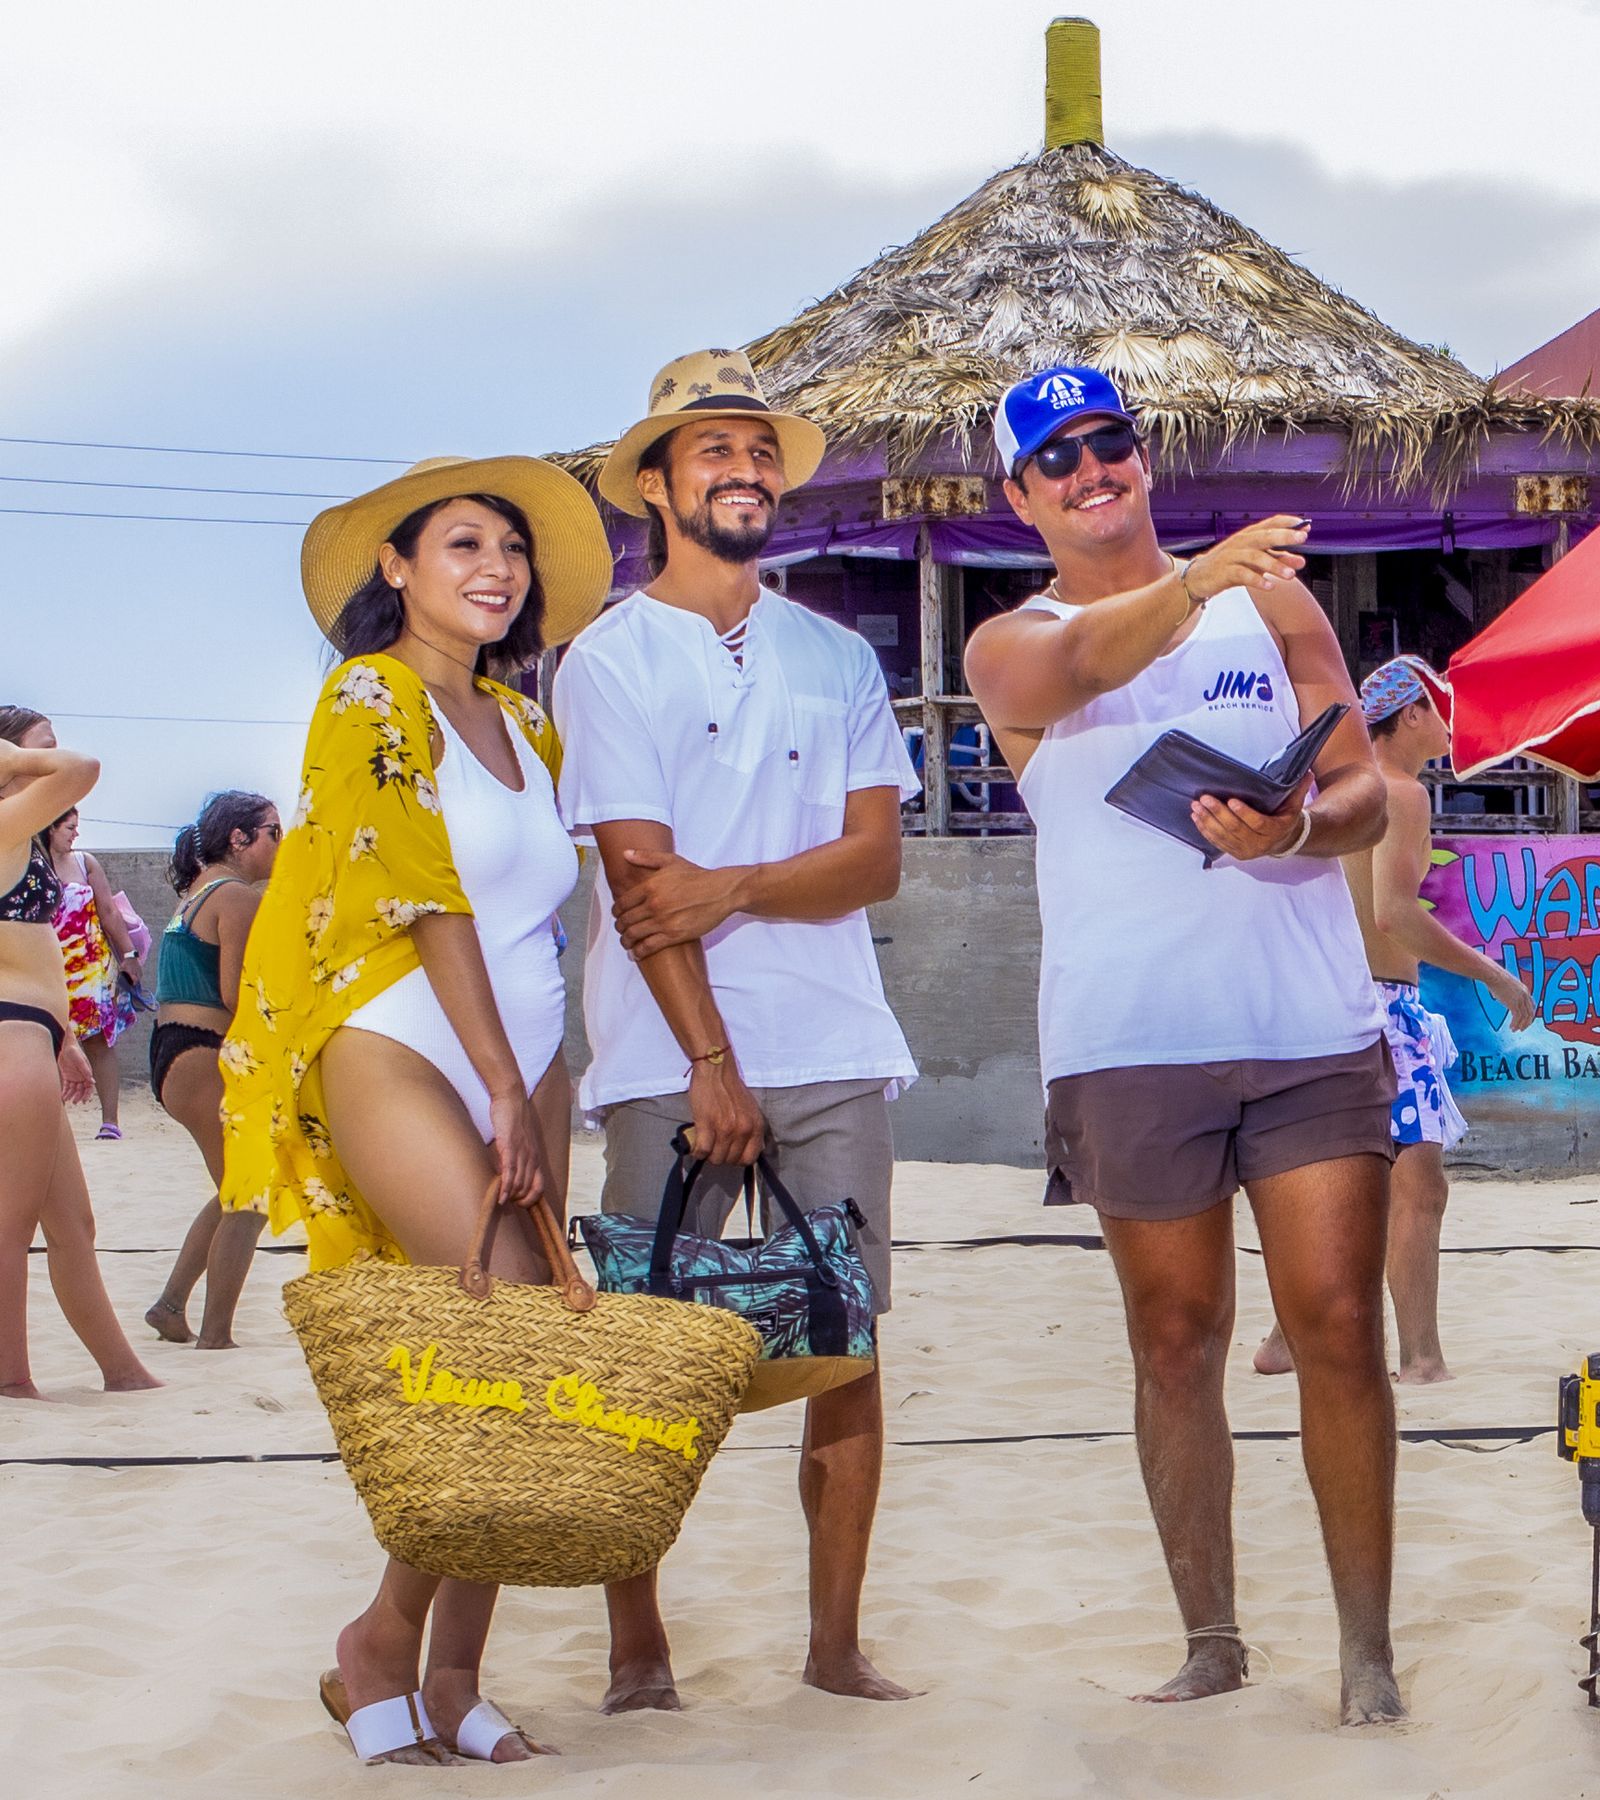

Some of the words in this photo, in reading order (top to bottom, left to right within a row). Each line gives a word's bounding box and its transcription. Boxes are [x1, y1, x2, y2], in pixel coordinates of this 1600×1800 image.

[1050, 387, 1082, 404] JBS
[1053, 396, 1085, 410] CREW
[1208, 702, 1238, 711] BEACH
[1241, 702, 1274, 713] SERVICE
[1459, 1049, 1551, 1083] BEACH
